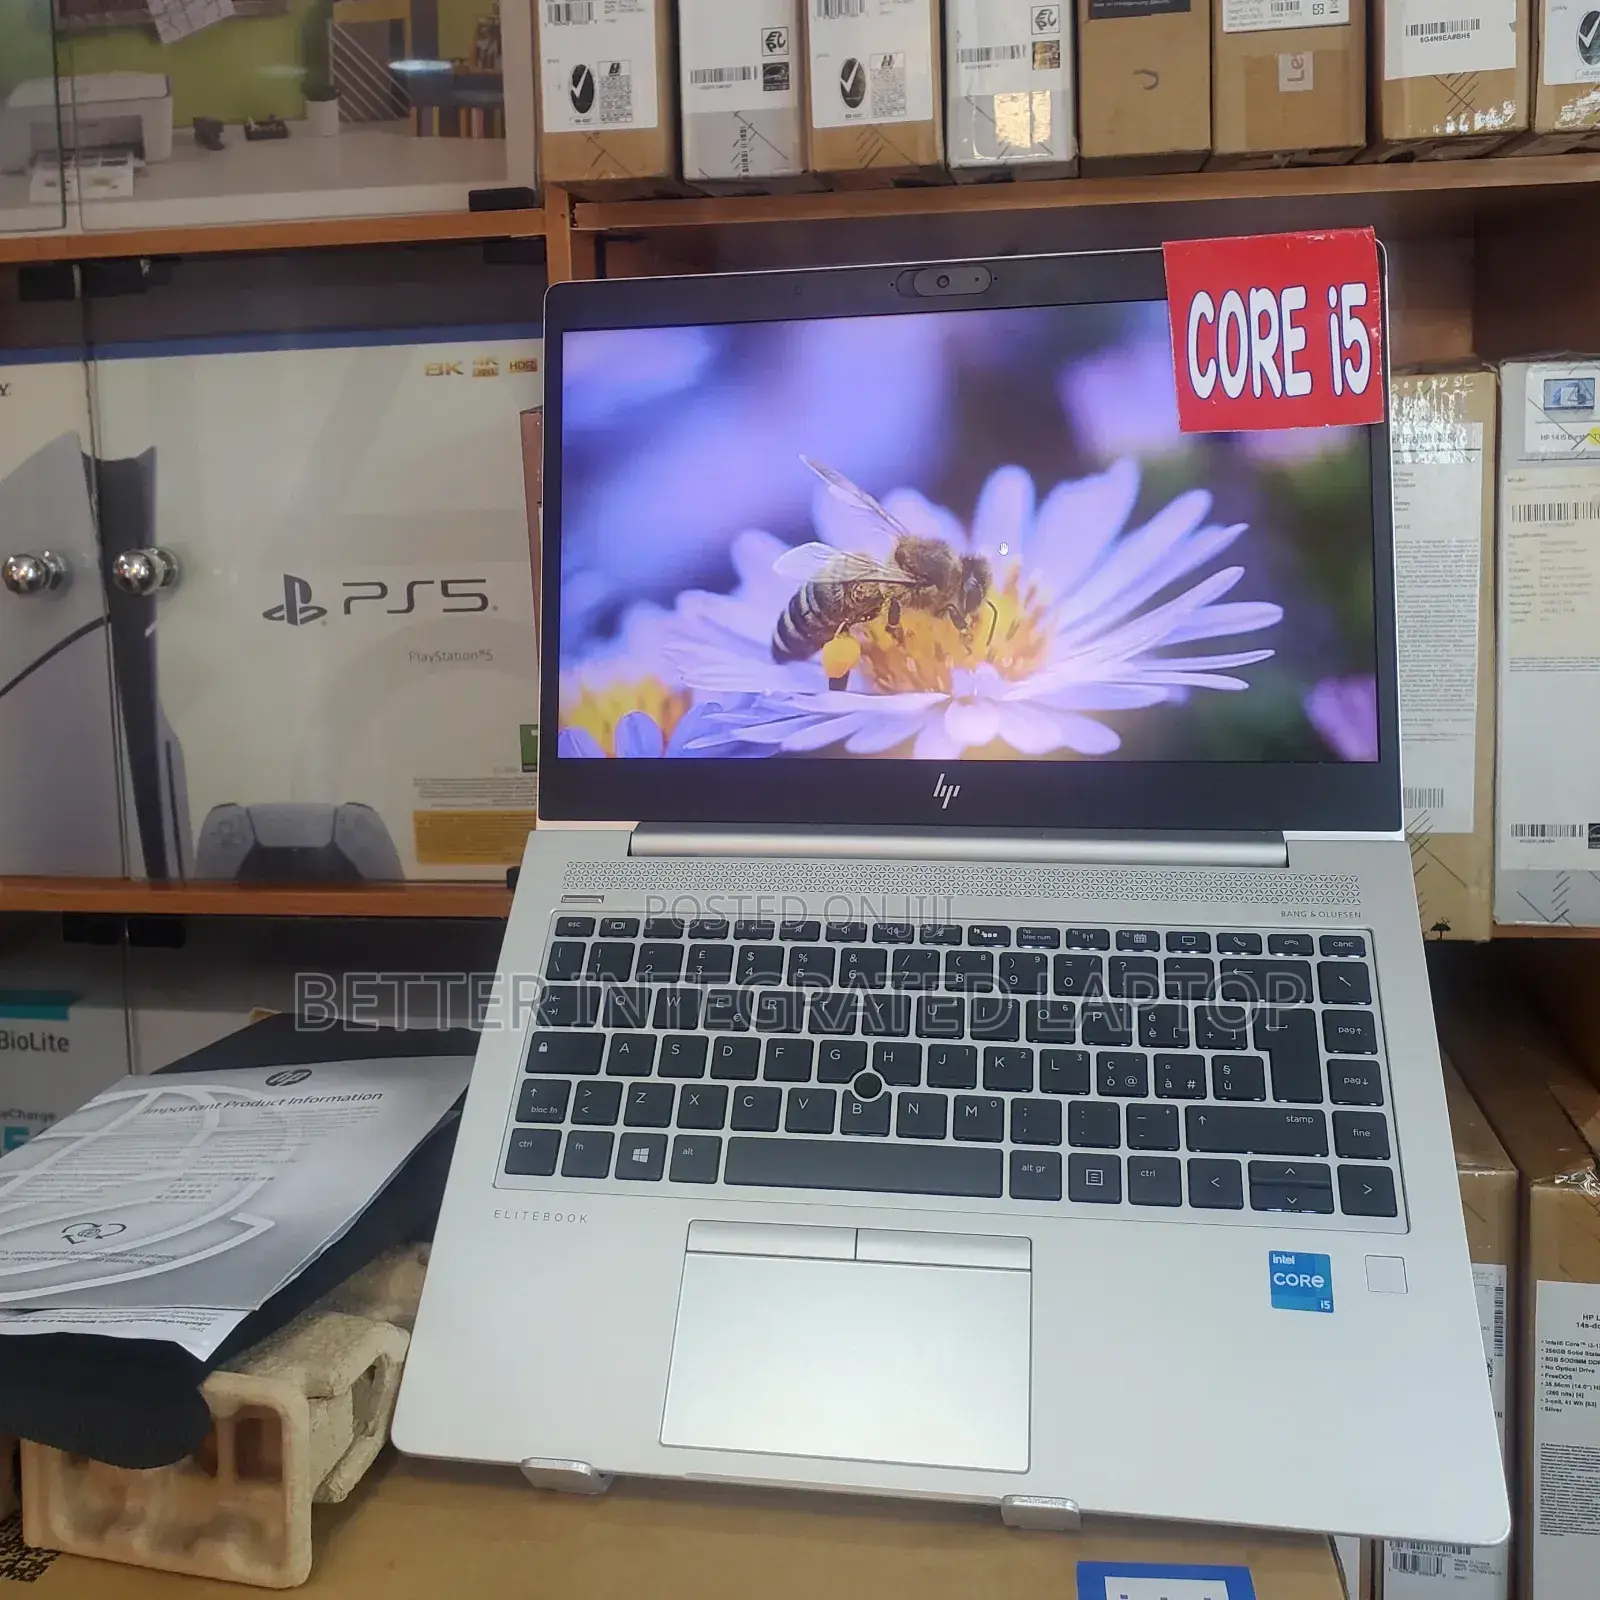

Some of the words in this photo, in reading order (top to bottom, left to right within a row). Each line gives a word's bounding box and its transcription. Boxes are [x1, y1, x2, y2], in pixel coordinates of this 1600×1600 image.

[1186, 283, 1314, 400] CORE
[1326, 281, 1373, 397] i5
[424, 361, 464, 376] 8K
[342, 578, 490, 615] PS5
[932, 773, 960, 810] hp
[1280, 910, 1308, 918] BANG
[1310, 910, 1316, 918] &
[1318, 910, 1362, 919] OLUFSEN
[698, 950, 706, 959] £
[746, 952, 754, 960] $
[798, 954, 808, 963] %
[850, 954, 858, 963] &
[644, 964, 653, 974] 2
[696, 965, 704, 974] 3
[745, 966, 754, 976] 4
[1120, 962, 1127, 971] ?
[797, 968, 805, 978] 5
[848, 970, 857, 979] 6
[901, 972, 910, 981] 7
[955, 972, 964, 982] 8
[1010, 975, 1018, 985] 9
[615, 996, 626, 1006] Q
[666, 996, 682, 1007] W
[716, 998, 724, 1008] E
[767, 1000, 776, 1010] R
[819, 1002, 828, 1012] T
[874, 1002, 884, 1014] Y
[928, 1004, 938, 1016] U
[732, 1013, 742, 1022] €
[1092, 1012, 1102, 1022] P
[1338, 1026, 1356, 1035] pag
[0, 1030, 70, 1053] BioLite
[618, 1043, 630, 1054] A
[671, 1044, 680, 1055] S
[722, 1046, 734, 1056] D
[775, 1048, 785, 1058] F
[830, 1050, 841, 1060] G
[882, 1052, 894, 1062] H
[938, 1054, 947, 1065] J
[1076, 1054, 1082, 1062] 3
[994, 1056, 1005, 1068] K
[1051, 1059, 1060, 1070] L
[1222, 1064, 1231, 1075] §
[1124, 1076, 1138, 1087] @
[1186, 1079, 1196, 1090] #
[1343, 1077, 1361, 1086] pag
[636, 1092, 646, 1103] Z
[688, 1094, 700, 1106] X
[744, 1096, 754, 1108] C
[142, 1101, 222, 1115] Important
[224, 1097, 286, 1110] Product
[288, 1092, 383, 1105] Information
[798, 1098, 810, 1109] V
[908, 1103, 919, 1114] N
[530, 1106, 548, 1114] bloc
[852, 1104, 862, 1114] B
[964, 1106, 978, 1116] M
[1286, 1116, 1314, 1124] stamp
[1352, 1128, 1370, 1137] fine
[518, 1140, 532, 1148] ctrl
[575, 1142, 584, 1150] fn
[682, 1148, 694, 1156] alt
[1022, 1164, 1033, 1172] alt
[1035, 1164, 1046, 1173] gr
[1140, 1169, 1156, 1178] ctrl
[494, 1209, 588, 1224] ELITEBOOK
[1272, 1254, 1296, 1265] intel
[1320, 1300, 1331, 1310] i5
